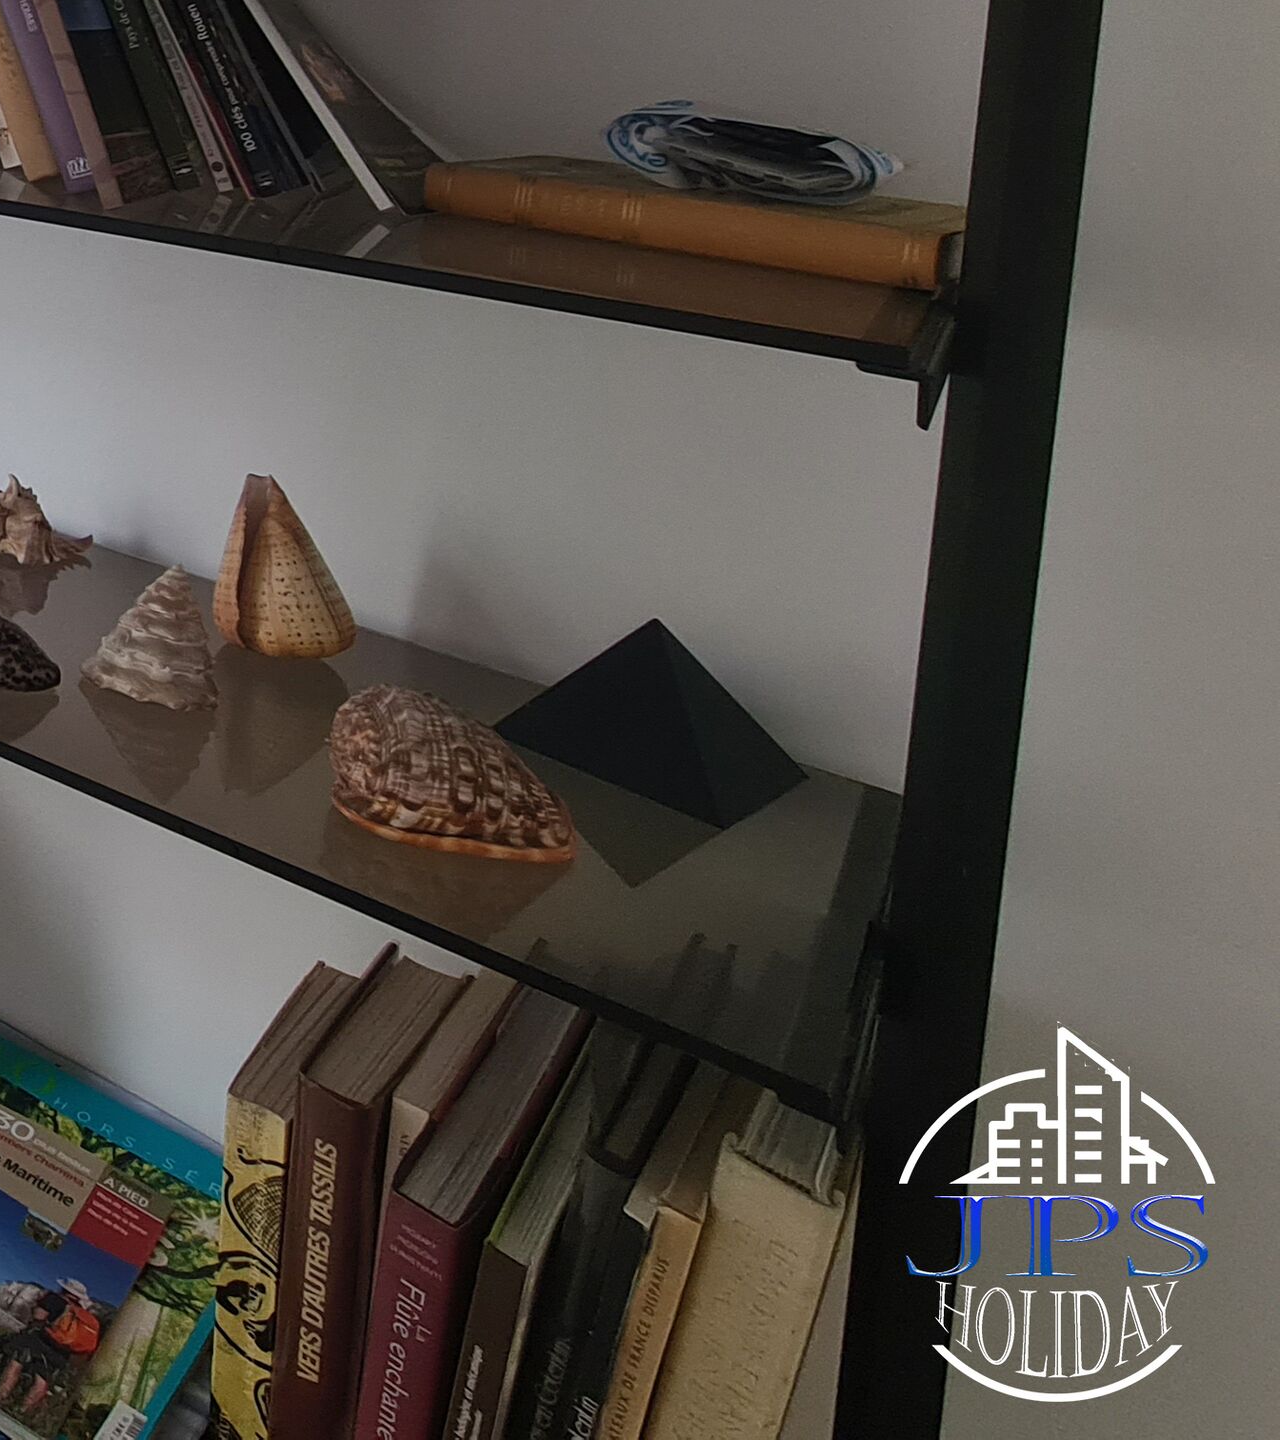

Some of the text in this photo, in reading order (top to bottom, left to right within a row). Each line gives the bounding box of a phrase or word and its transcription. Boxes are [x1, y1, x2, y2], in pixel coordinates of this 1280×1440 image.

[18, 5, 39, 33] HOMMES
[184, 2, 210, 42] Rouen
[124, 25, 141, 50] Pays
[227, 104, 249, 131] clés
[239, 129, 258, 153] 100
[2, 1157, 76, 1208] Maritime
[118, 1184, 150, 1208] PIED
[296, 1137, 339, 1384] VERS D'AUTRES TASSILIS
[644, 1256, 672, 1320] DISPARUS
[395, 1276, 428, 1339] Flûte
